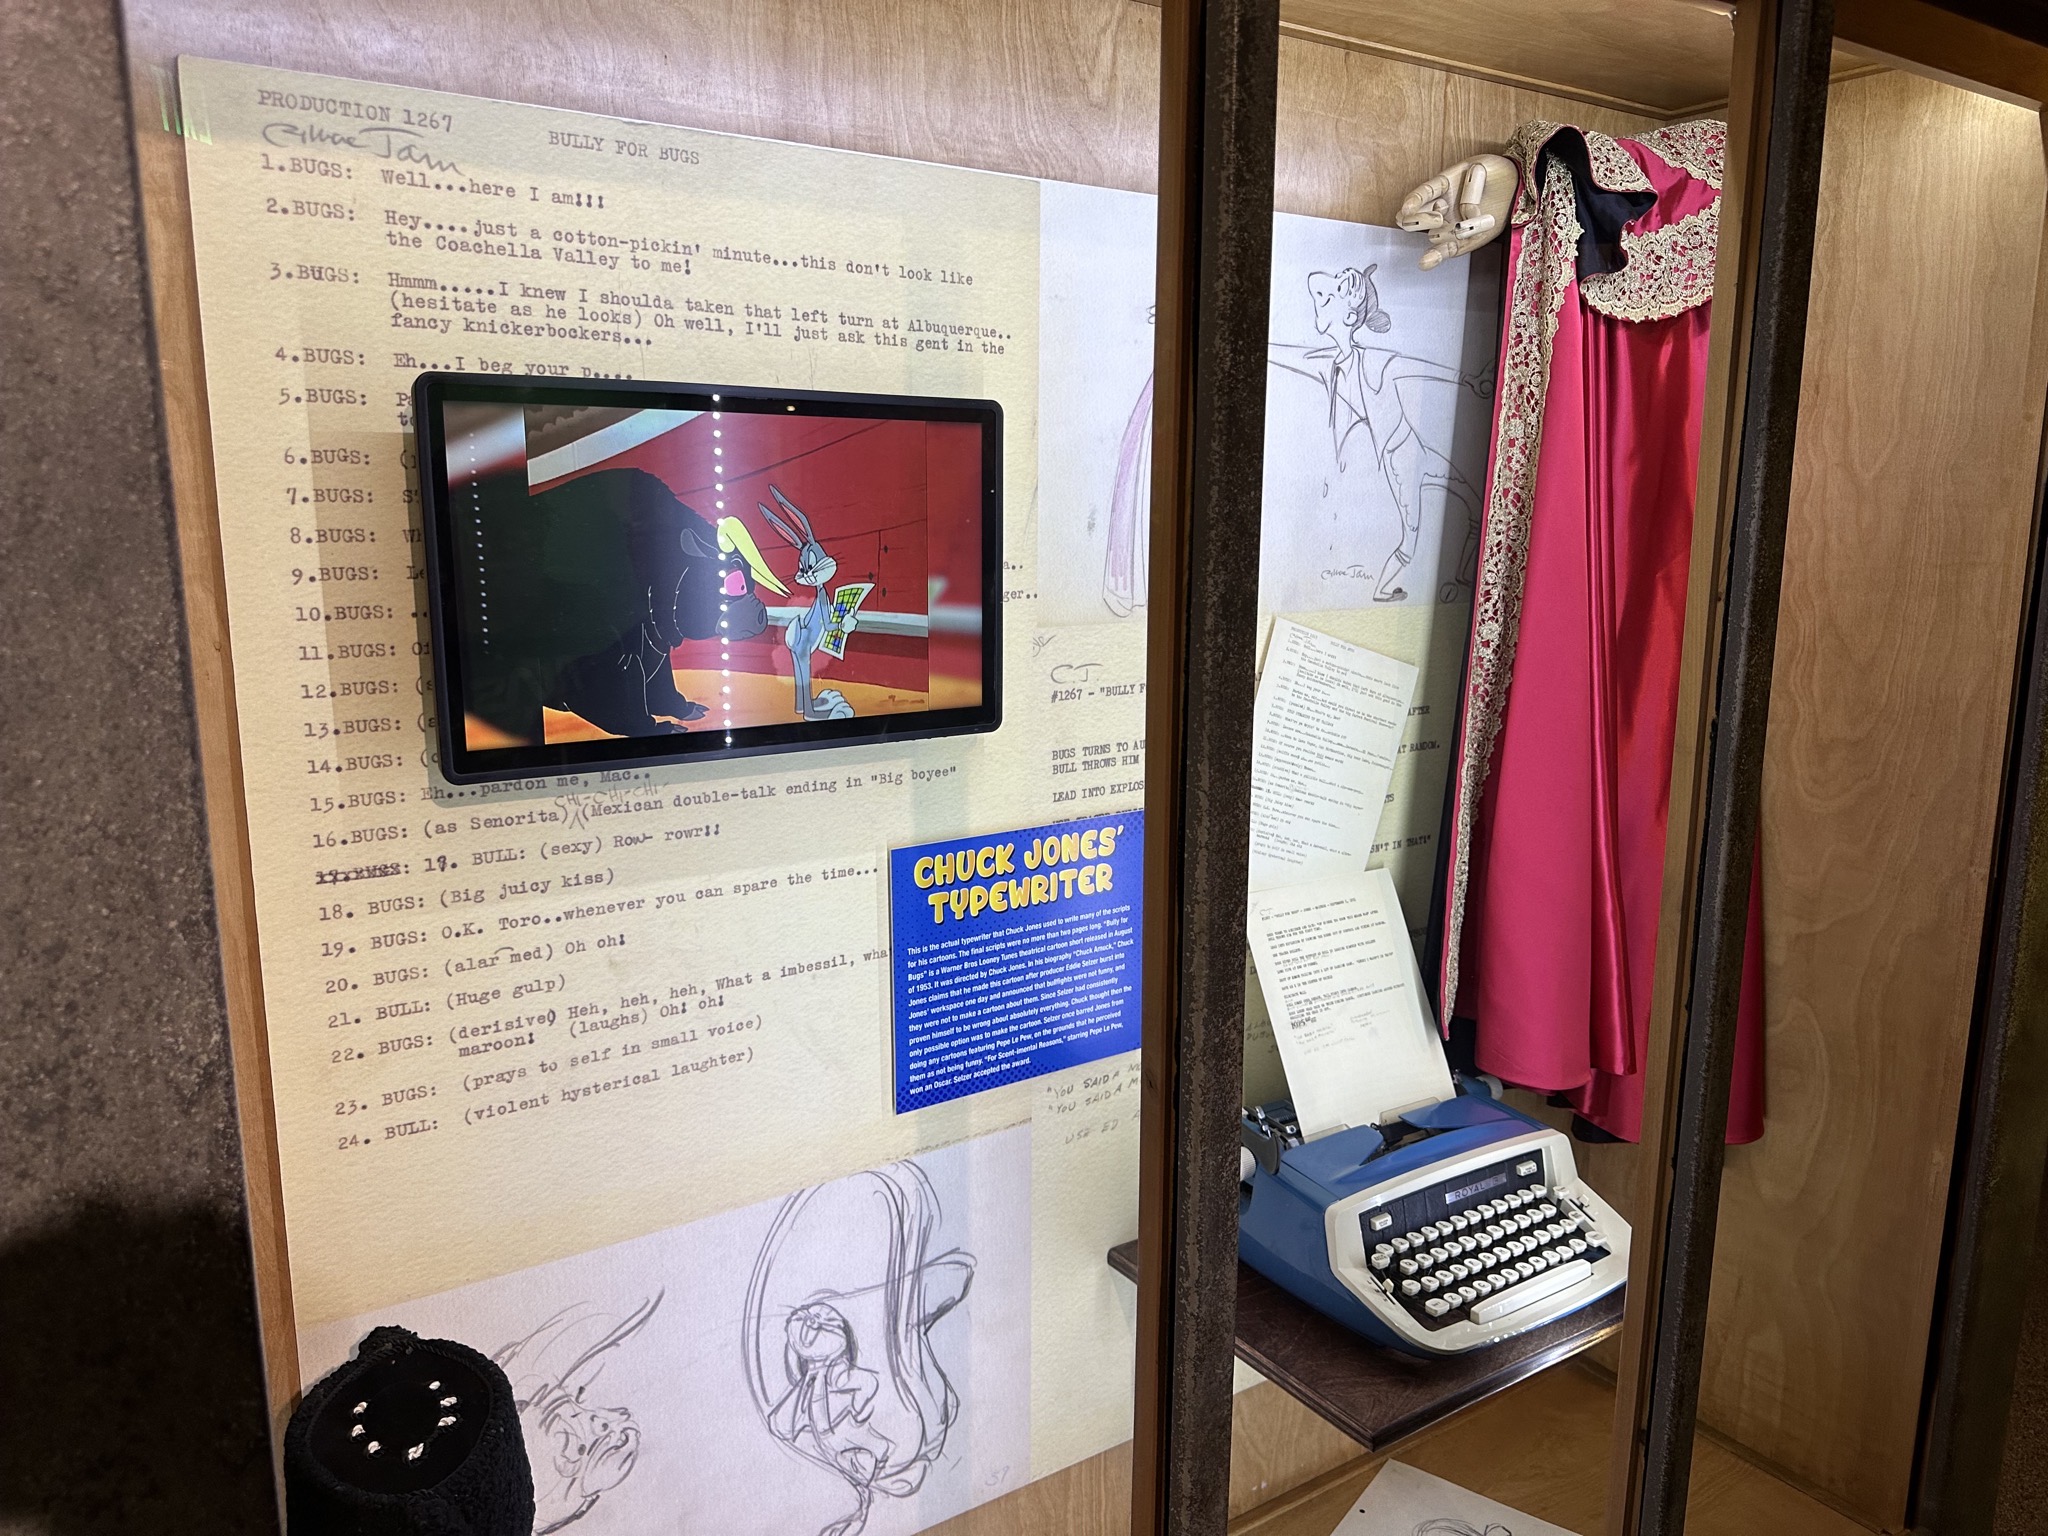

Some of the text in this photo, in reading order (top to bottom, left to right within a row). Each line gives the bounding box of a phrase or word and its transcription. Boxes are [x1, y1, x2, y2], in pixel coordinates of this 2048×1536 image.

[258, 89, 452, 132] PRODUCTION 1267
[549, 131, 700, 165] BULLY FOR BUGS
[261, 154, 352, 179] 1.BUGS:
[267, 198, 355, 222] 2.BUGS:
[553, 229, 701, 258] cotton-pickin'
[846, 261, 890, 278] don't
[899, 266, 932, 283] look
[940, 270, 973, 286] like
[387, 233, 692, 276] the Coachella Valley to me!
[270, 263, 360, 285] 3.BUGS:
[520, 283, 566, 301] knew
[600, 290, 675, 311] shoulda
[685, 299, 733, 317] taken
[744, 304, 782, 320] that
[791, 308, 829, 325] left
[839, 314, 874, 330] turn
[883, 317, 899, 331] at
[391, 290, 1004, 355] (hesitate as he looks) Oh well, I'll just ask this gent in the
[391, 314, 451, 334] fancy
[275, 348, 365, 365] 4.BUGS:
[279, 387, 367, 406] 5.BUGS:
[284, 448, 371, 467] 6.BUGS:
[286, 487, 373, 505] 7.BUGS:
[290, 527, 376, 544] 8.BUGS:
[291, 566, 378, 585] 9.BUGS:
[295, 605, 394, 622] 10.BUGS:
[299, 642, 396, 661] 11.BUGS:
[301, 680, 399, 699] 12.BUGS:
[1051, 685, 1135, 703] #1267 "BULLY
[1408, 706, 1430, 716] AFTER
[304, 716, 401, 737] 13.BUGS:
[308, 754, 403, 774] 14.BUGS:
[1052, 742, 1128, 760] BUGS TURNS TO
[1052, 755, 1139, 774] BULL THROWS HIM
[310, 790, 406, 812] 15.BUGS:
[556, 774, 589, 788] me,
[1053, 787, 1106, 803] LEAD INTO
[313, 766, 956, 848] 16.BUGS: (as Senorita) (Mexican double-talk ending in "Big boyee"
[472, 837, 602, 866] BULL: (sexy)
[913, 824, 1124, 889] CHUCK JONES'
[319, 868, 615, 921] 18. BUGS: (Big juicy kiss)
[928, 863, 1113, 924] TYPEWRITER
[321, 867, 878, 956] 19. BUGS: O.K. you can spare the time...
[907, 947, 921, 955] This
[930, 943, 939, 951] the
[941, 939, 960, 949] actual
[961, 932, 991, 946] typewriter
[993, 930, 1004, 938] that
[1005, 925, 1024, 936] Chuck
[1025, 923, 1041, 931] Jones
[1043, 919, 1056, 927] used
[1065, 915, 1078, 923] write
[1080, 912, 1094, 920] many
[1112, 905, 1130, 914] scripts
[941, 964, 962, 974] Warner
[979, 957, 1000, 966] Looney
[1001, 951, 1018, 960] Tunes
[326, 967, 429, 994] 20. BUGS:
[328, 974, 566, 1028] 21. BULL: (Huge gulp)
[332, 954, 855, 1063] 22. BUGS: What imbessil,
[458, 1002, 687, 1058] maroon! (laughs) Oh!
[382, 1015, 763, 1106] BUGS: (prays to self in small voice)
[910, 1057, 1031, 1095] won Oscar. Selzer accepted the award.
[338, 1048, 754, 1151] 24. BULL: (violent hysterical laughter)
[1455, 1183, 1485, 1199] ROYAL
